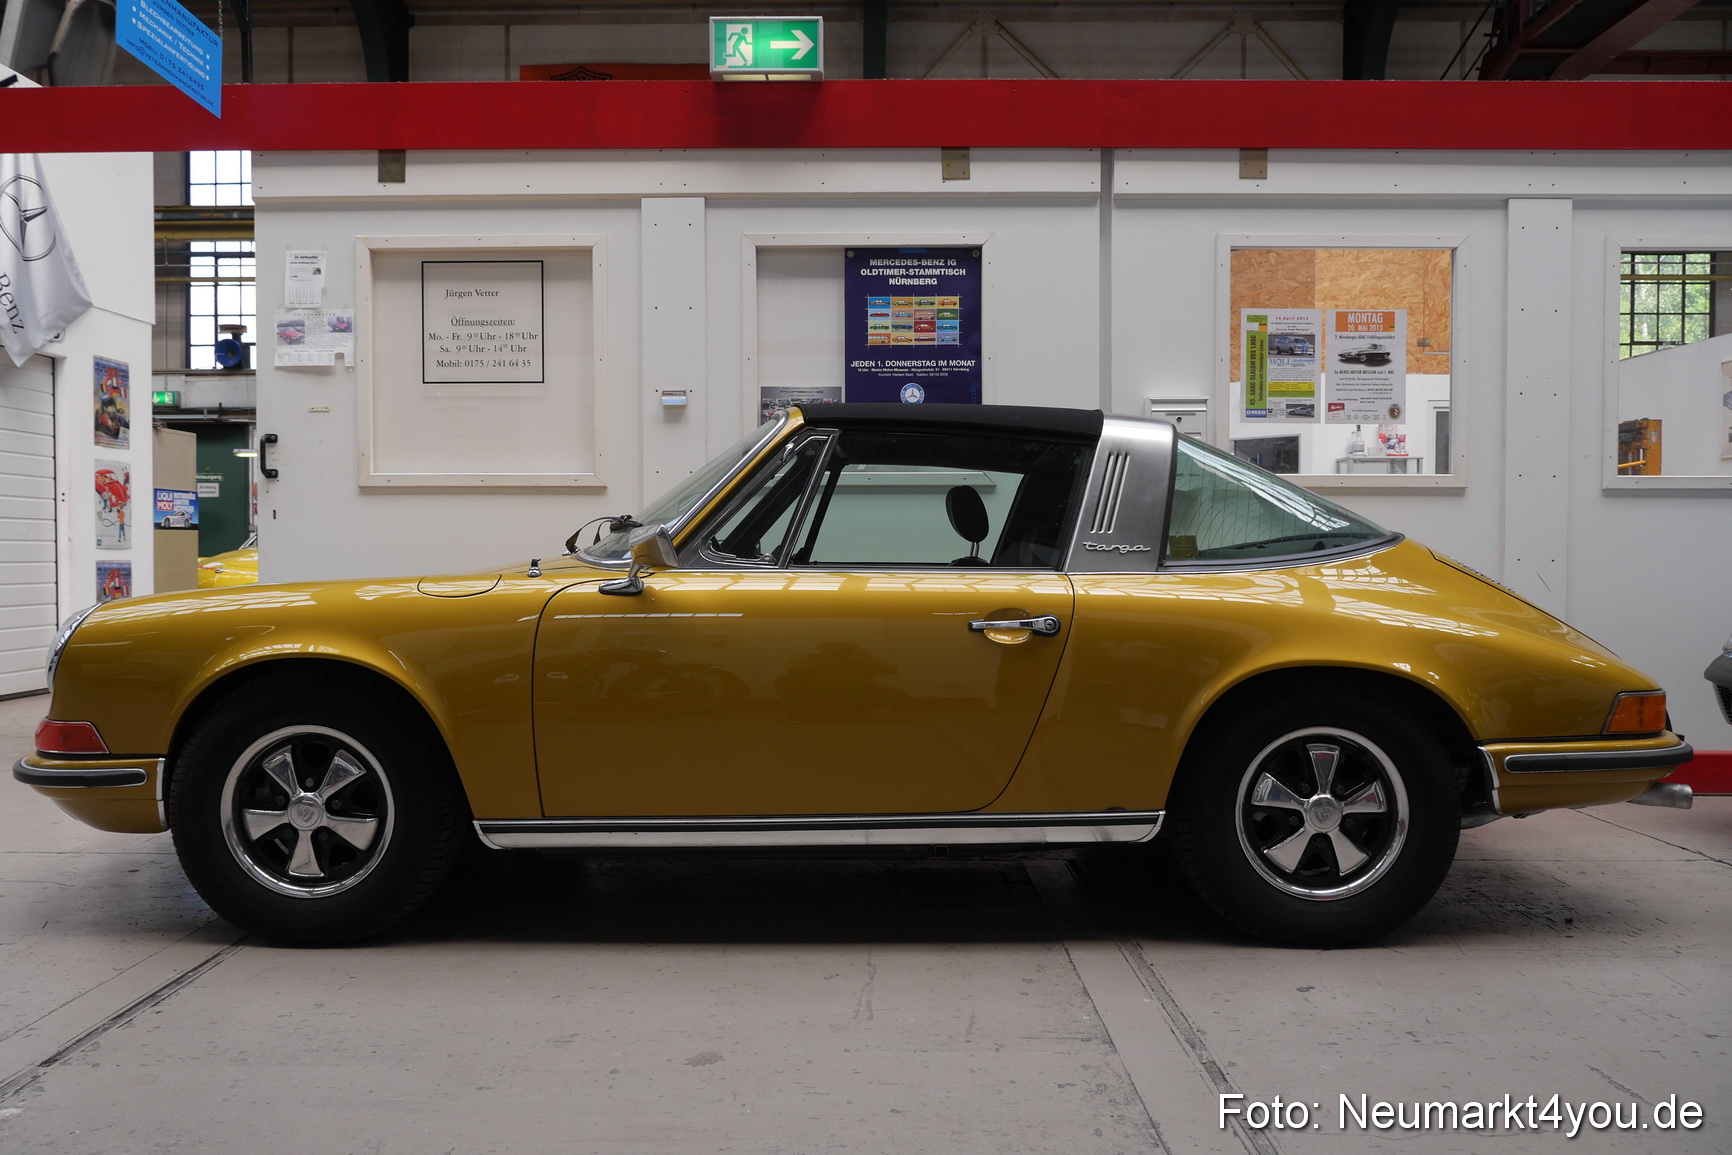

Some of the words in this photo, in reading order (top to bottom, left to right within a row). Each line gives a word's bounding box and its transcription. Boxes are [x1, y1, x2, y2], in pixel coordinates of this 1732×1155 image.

[860, 268, 966, 276] OLDTIMER-STAMMTISCH
[888, 276, 938, 285] NÜRNBERG
[444, 288, 473, 299] Jürgen
[475, 289, 500, 297] Vetter
[0, 271, 25, 334] Benz
[450, 316, 516, 327] Öffnungszeiten:
[1347, 312, 1383, 323] MONTAG
[521, 332, 539, 340] Uhr
[440, 345, 451, 353] Sa.
[468, 344, 485, 352] Uhr
[510, 344, 527, 352] Uhr
[492, 359, 506, 368] 241
[509, 359, 519, 368] 64
[522, 359, 531, 368] 35
[1083, 541, 1151, 554] targa
